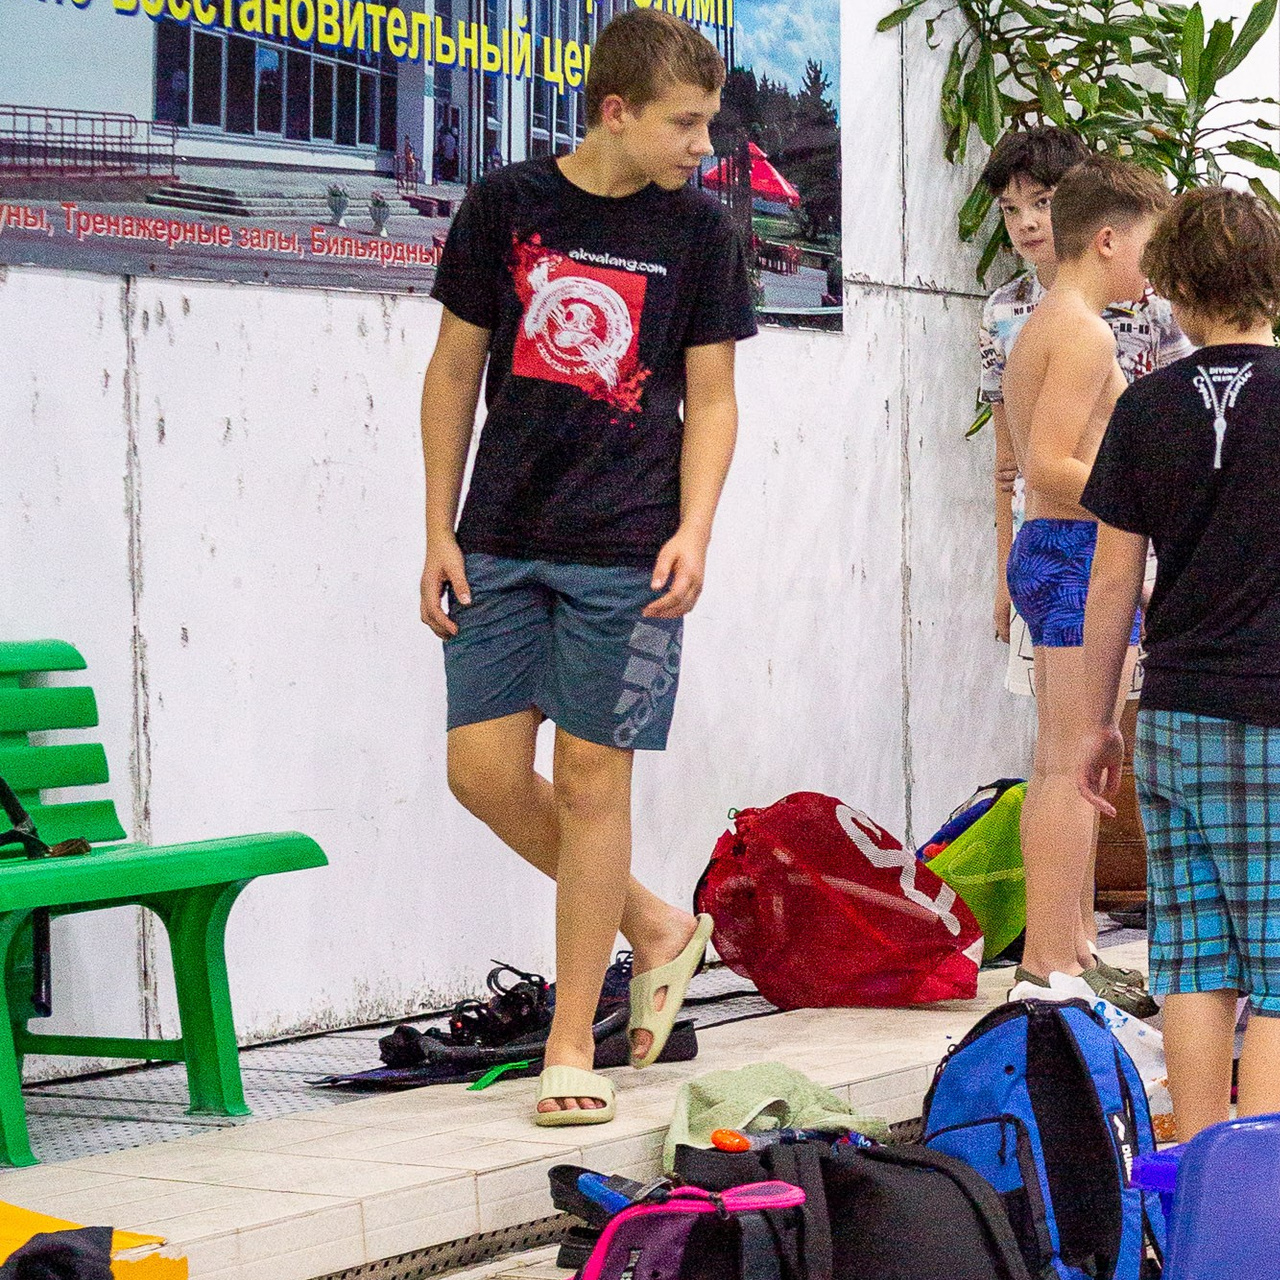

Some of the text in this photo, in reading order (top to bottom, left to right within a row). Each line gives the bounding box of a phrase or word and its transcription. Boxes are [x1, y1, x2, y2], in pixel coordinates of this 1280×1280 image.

[60, 201, 233, 249] Тренажерные
[238, 224, 305, 259] залы,
[568, 247, 668, 277] akvalang.com
